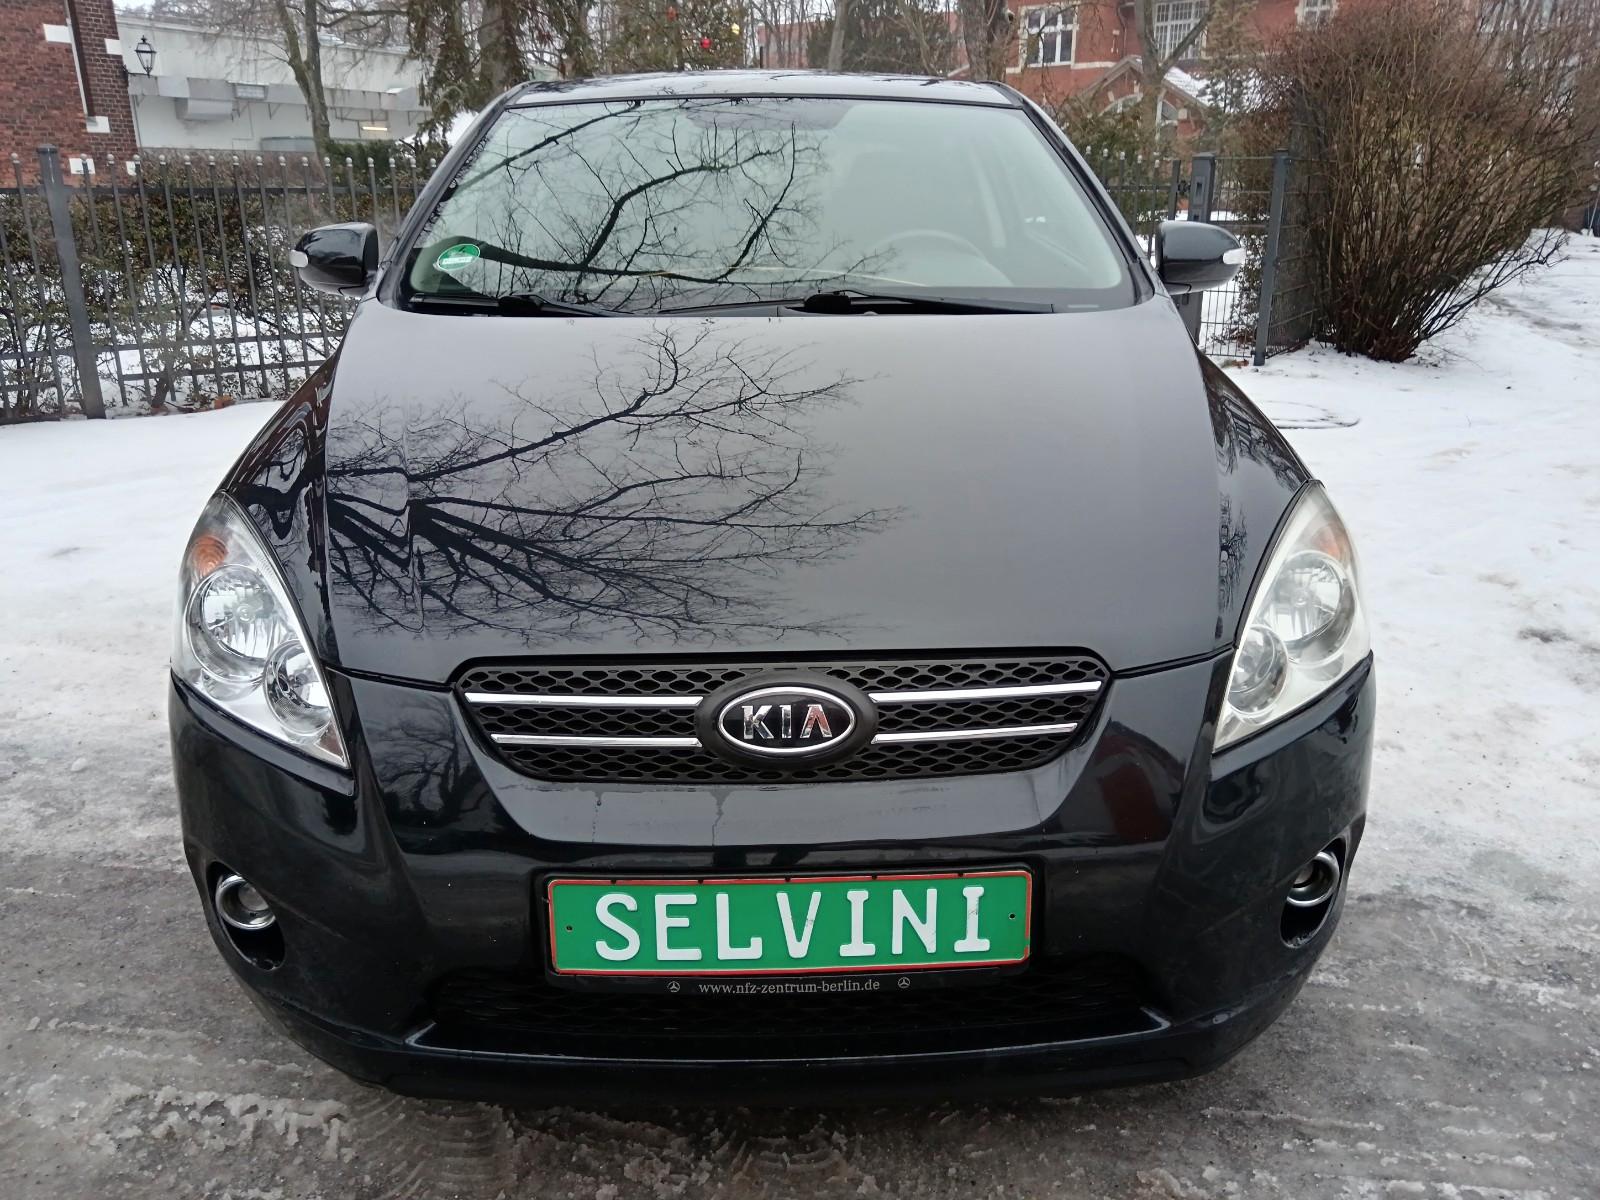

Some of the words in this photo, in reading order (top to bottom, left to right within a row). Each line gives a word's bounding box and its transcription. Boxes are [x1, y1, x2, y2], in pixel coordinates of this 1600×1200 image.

[741, 704, 832, 739] KIA
[595, 885, 991, 962] SELVINI
[698, 978, 881, 994] www.nfz-zentrum-berlin.de
